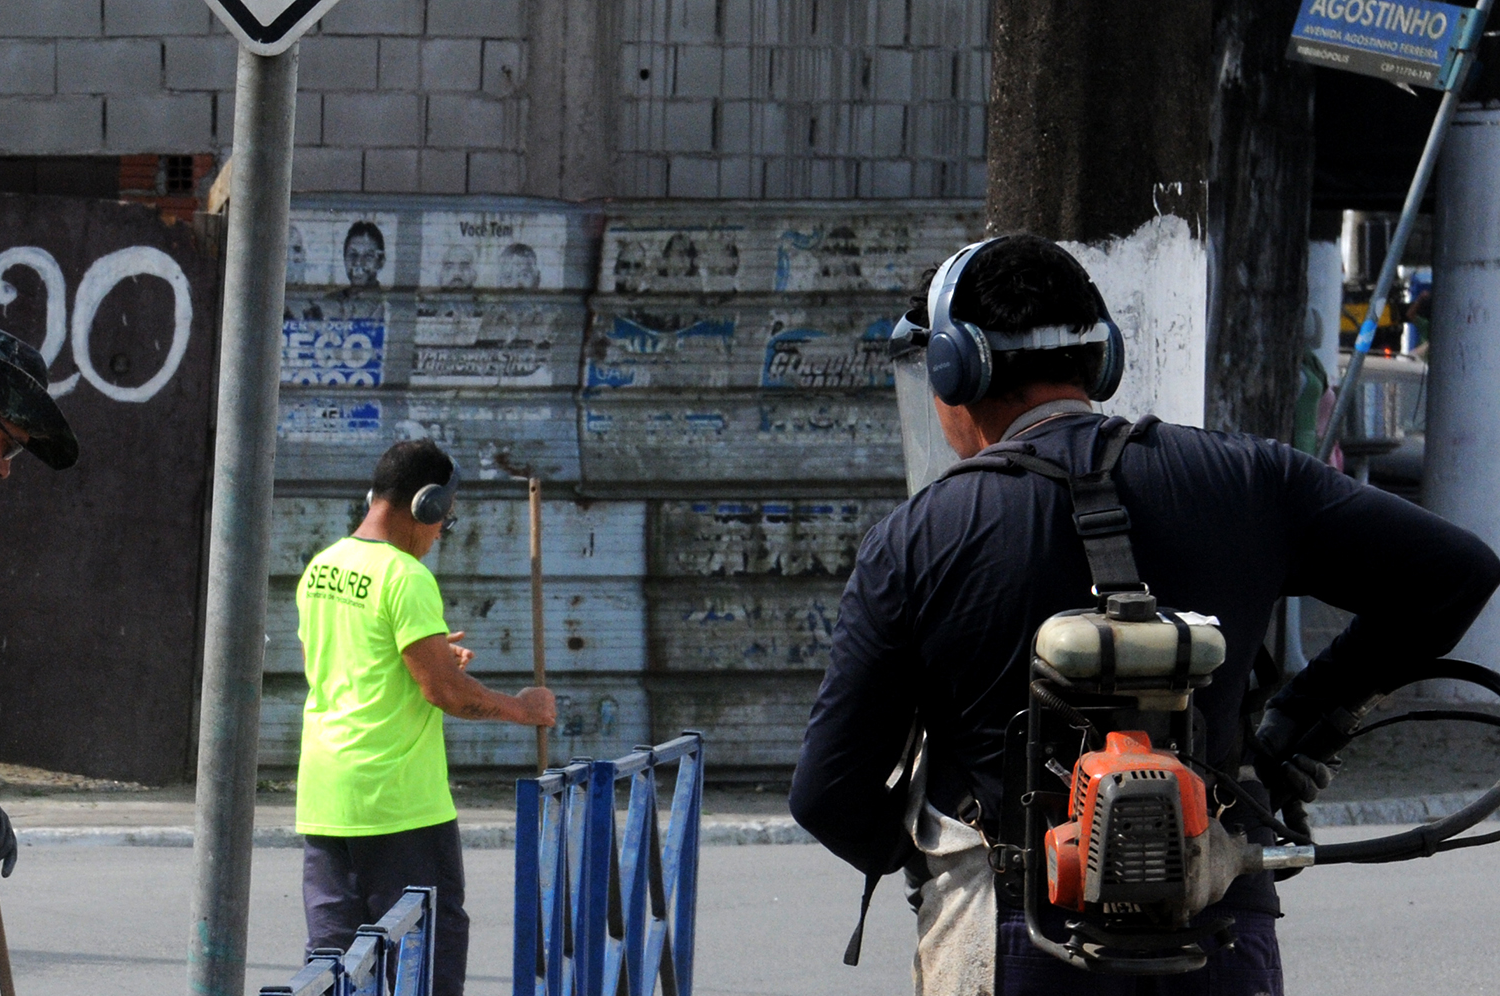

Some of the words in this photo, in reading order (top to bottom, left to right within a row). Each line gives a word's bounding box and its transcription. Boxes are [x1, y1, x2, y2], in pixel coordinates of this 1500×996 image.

[1309, 0, 1448, 40] AGOSTINHO
[1303, 24, 1342, 40] AVENIDA
[1344, 32, 1399, 52] AGOSTINHO
[1399, 42, 1439, 60] FERREIRA
[307, 565, 372, 599] SESURB
